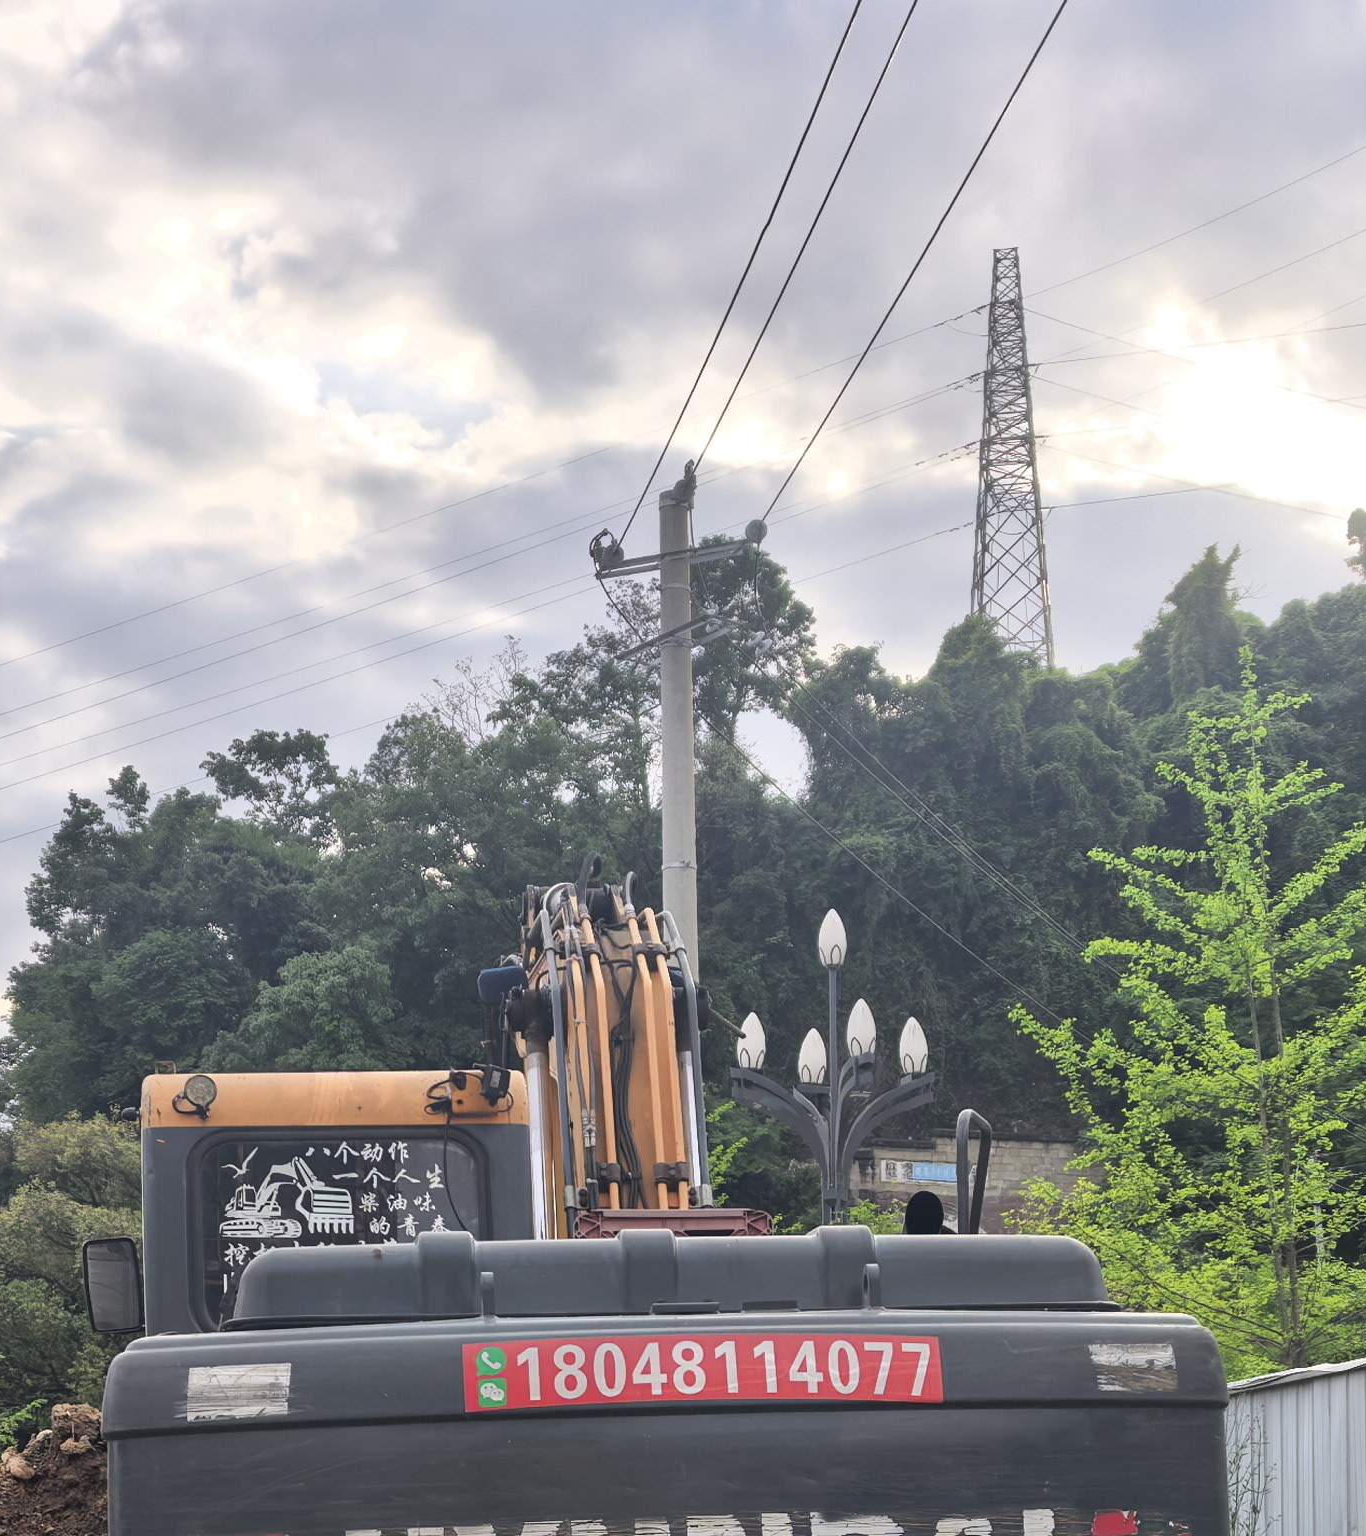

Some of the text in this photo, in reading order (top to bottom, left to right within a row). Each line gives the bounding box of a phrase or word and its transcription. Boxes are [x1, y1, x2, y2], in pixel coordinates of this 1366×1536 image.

[305, 1141, 410, 1164] 八个动作
[332, 1163, 444, 1189] 一个人生
[359, 1192, 436, 1212] 柴油味
[516, 1340, 932, 1400] 18048114077
